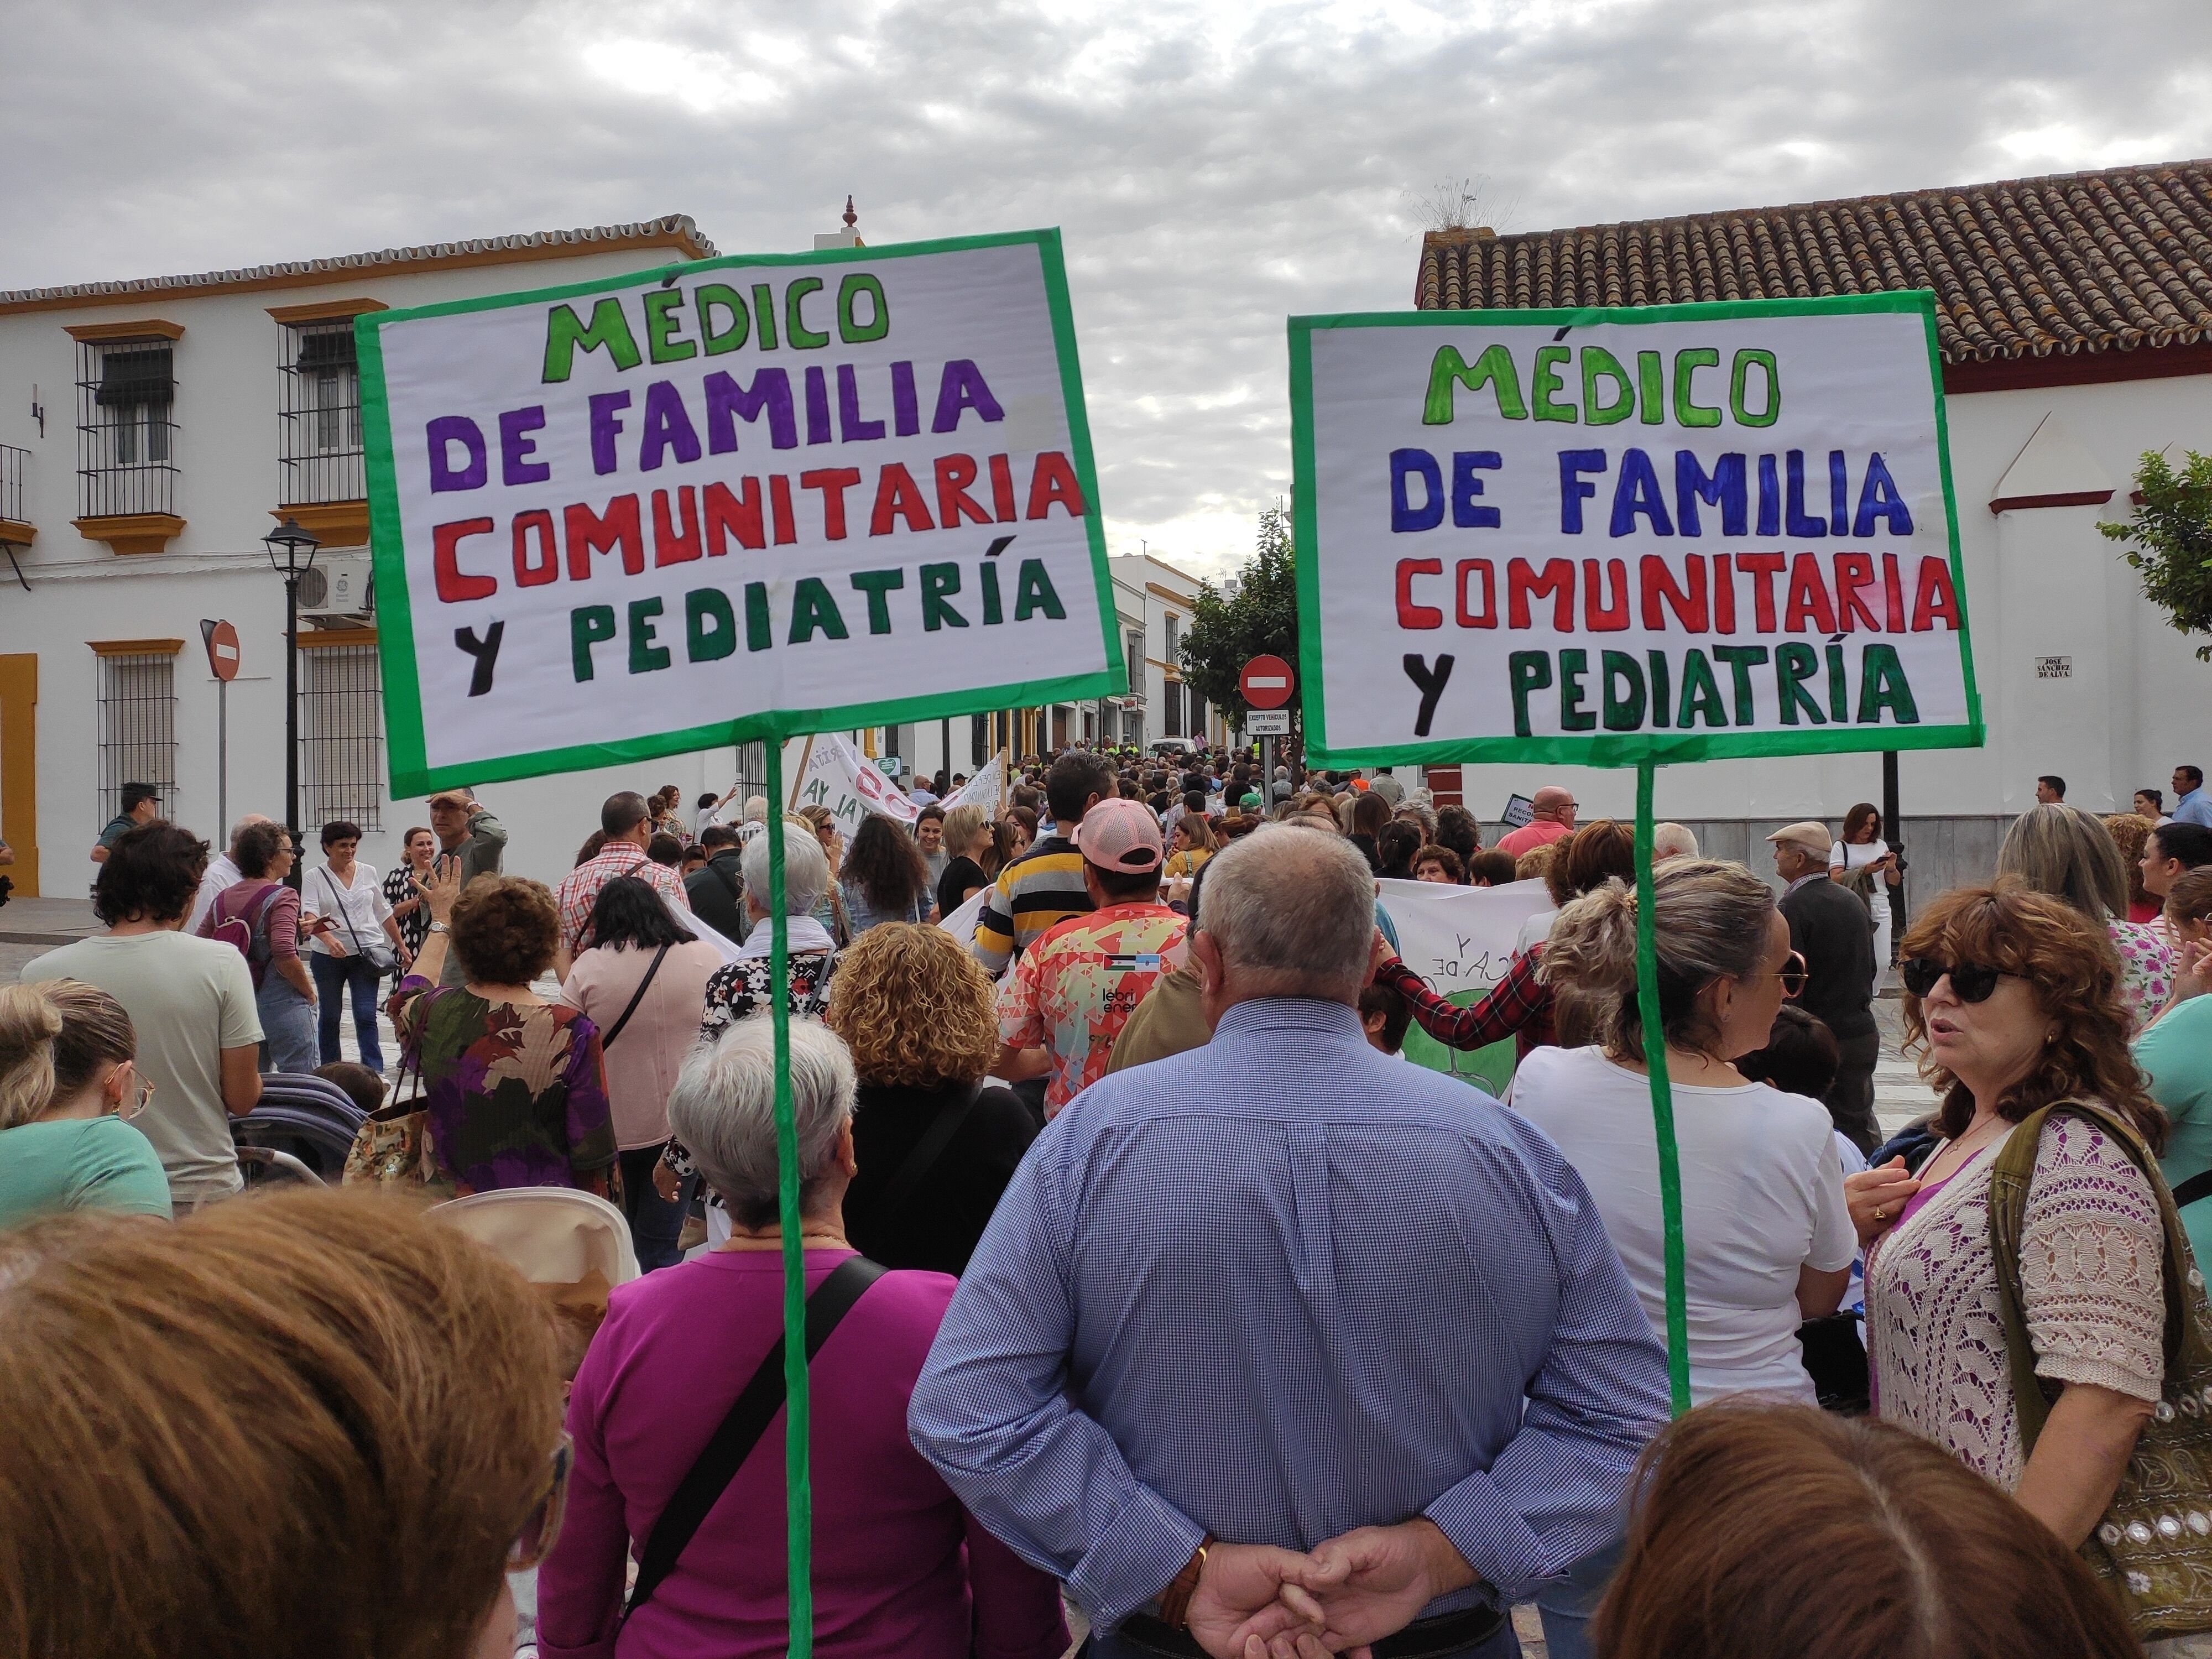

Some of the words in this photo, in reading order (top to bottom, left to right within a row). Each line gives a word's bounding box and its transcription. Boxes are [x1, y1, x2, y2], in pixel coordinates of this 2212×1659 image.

[542, 260, 889, 384] MÉDICO
[426, 405, 550, 494] DE
[589, 359, 1005, 475] FAMILIA
[1422, 326, 1781, 427] MÉDICO
[432, 451, 1093, 603] COMUNITARIA
[1389, 448, 1502, 533] DE
[1557, 448, 1914, 538] FAMILIA
[454, 620, 504, 697] Y
[571, 535, 1066, 682] PEDIATRÍA
[1395, 551, 1965, 634] COMUNITARIA
[1403, 654, 1455, 737] Y
[1509, 634, 1920, 737] PEDIATRÍA
[1103, 988, 1133, 1001] lebri
